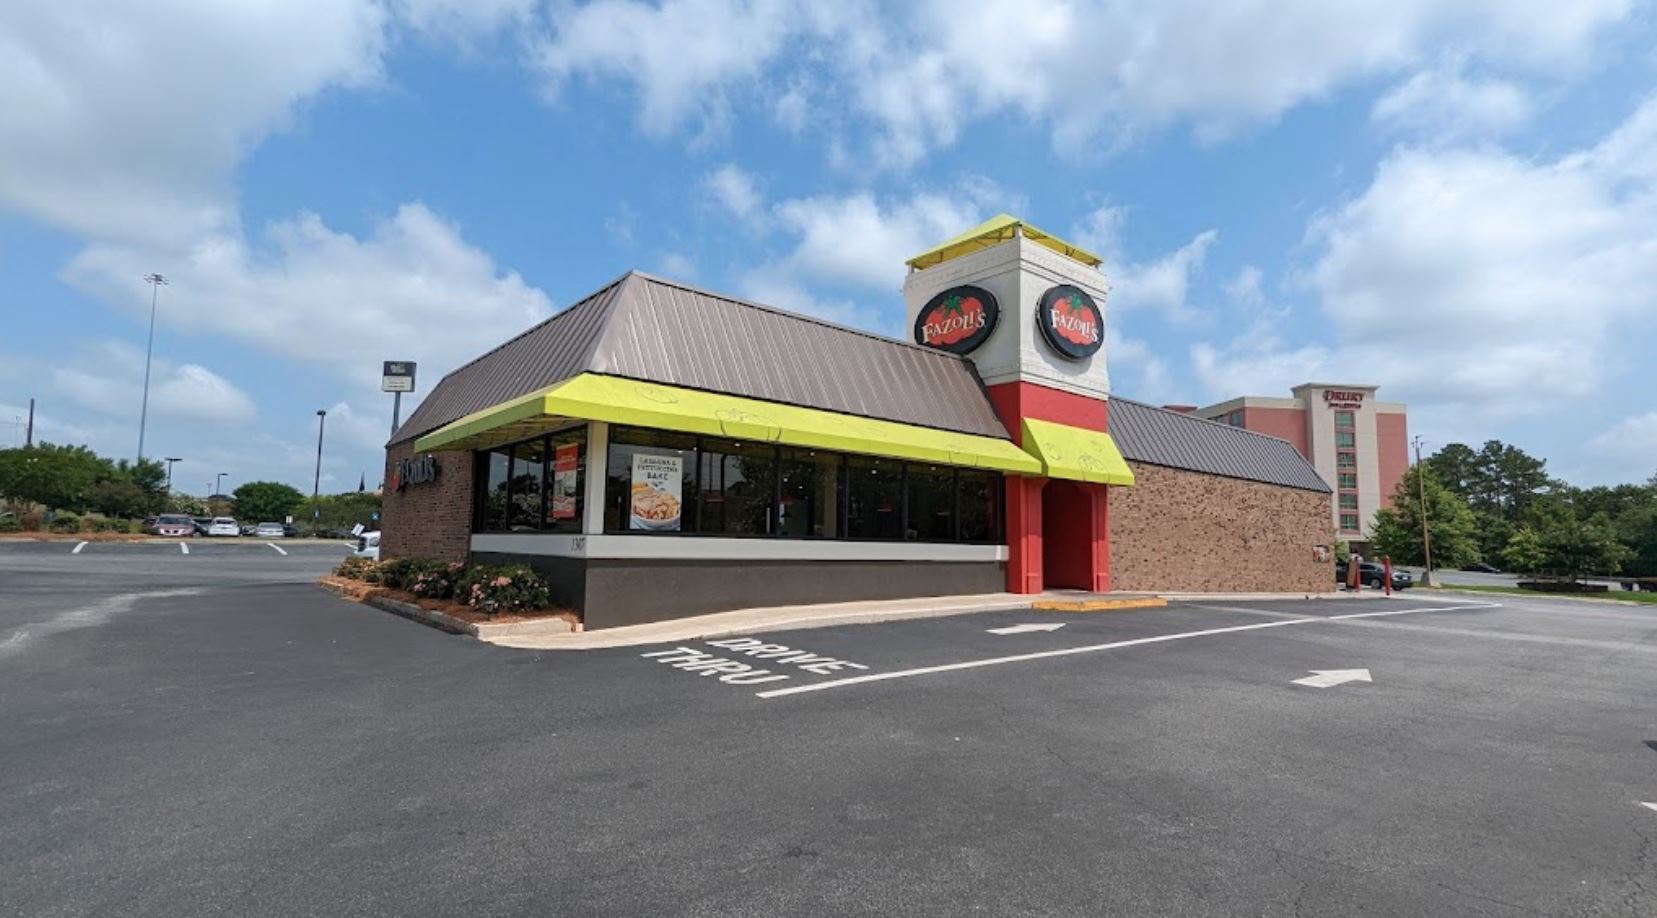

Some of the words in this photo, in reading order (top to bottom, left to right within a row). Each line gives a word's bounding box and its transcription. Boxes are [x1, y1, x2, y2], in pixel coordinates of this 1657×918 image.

[922, 309, 987, 344] FAZOLI'S
[1050, 309, 1099, 343] FAZOLI'S
[1322, 390, 1365, 401] DRURY
[647, 472, 668, 480] BAKE
[640, 646, 791, 685] THRU
[705, 638, 870, 675] DRIVE
